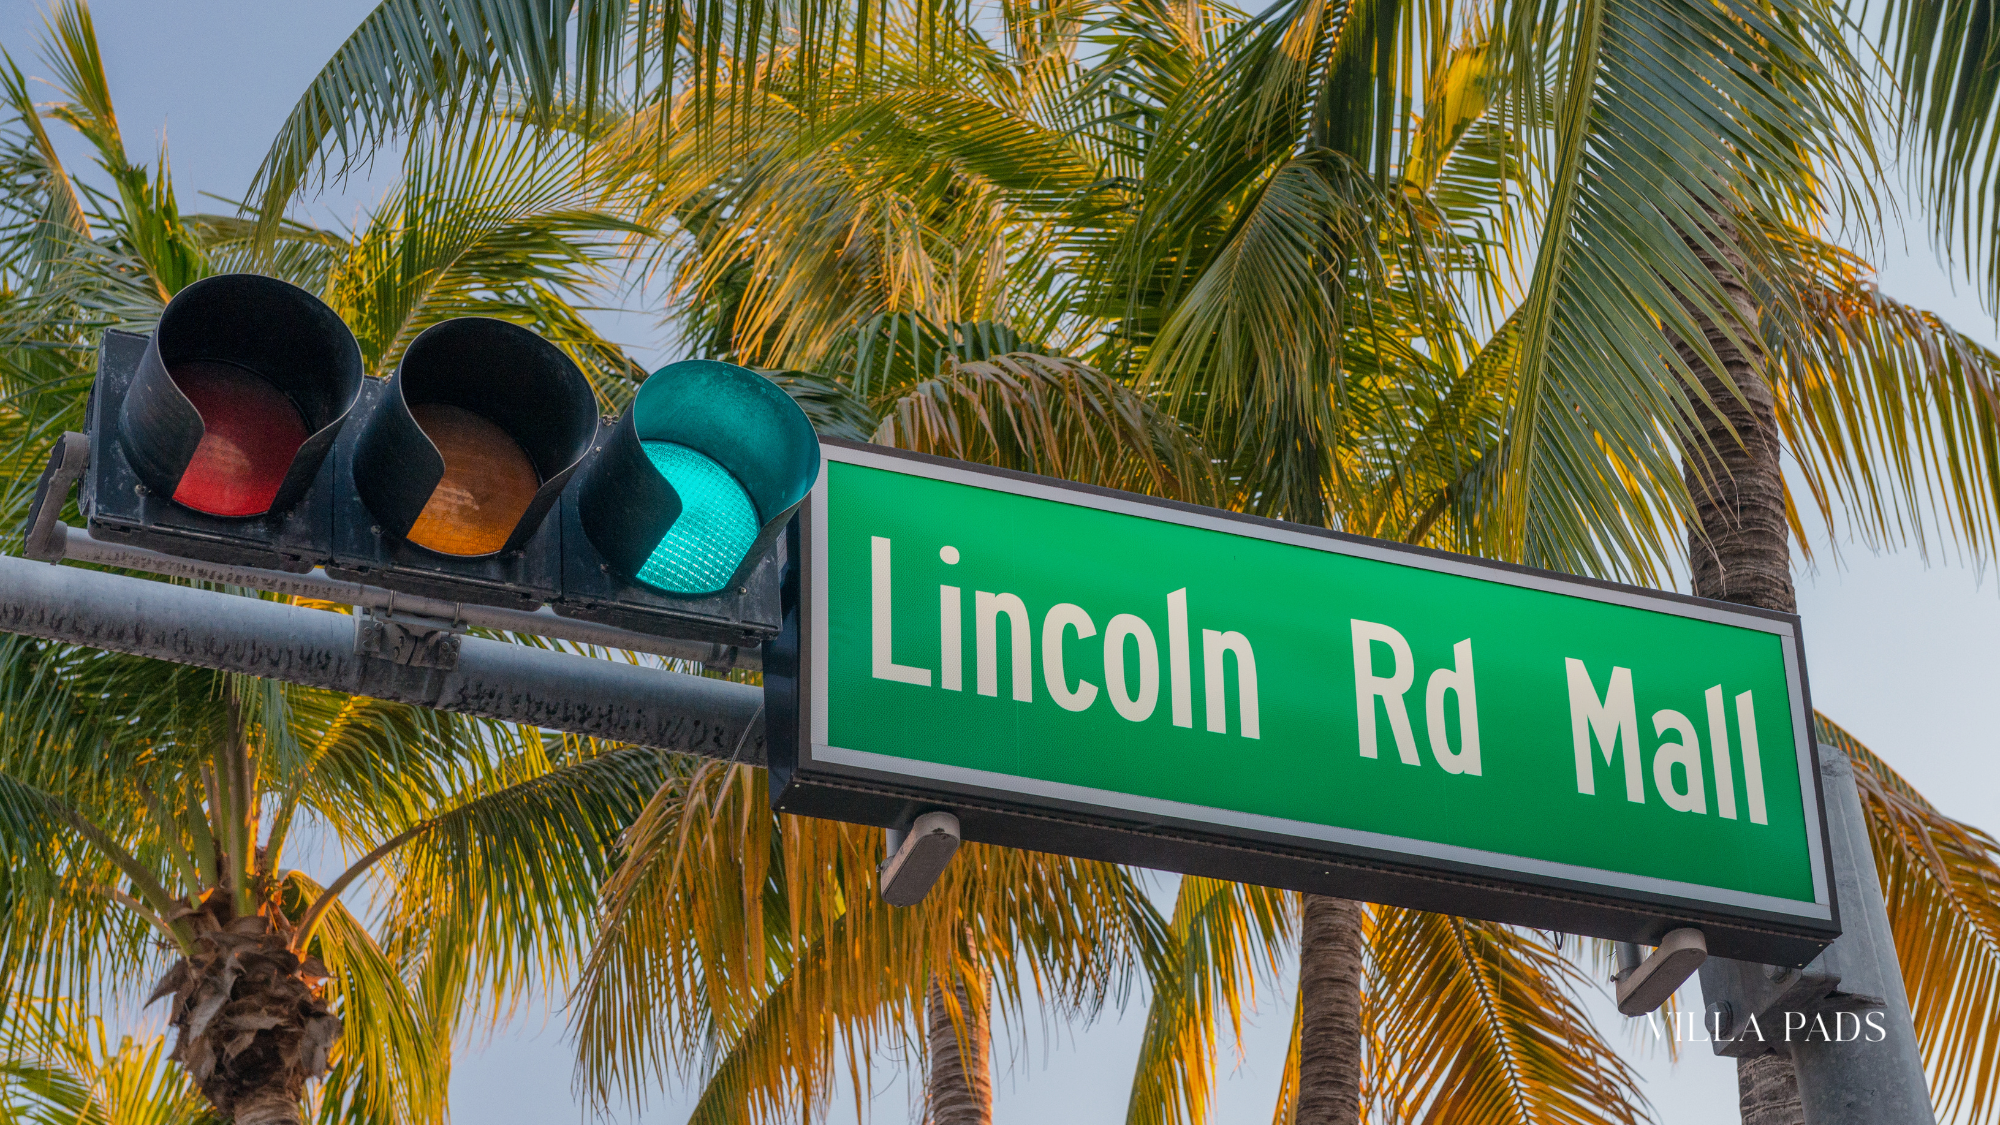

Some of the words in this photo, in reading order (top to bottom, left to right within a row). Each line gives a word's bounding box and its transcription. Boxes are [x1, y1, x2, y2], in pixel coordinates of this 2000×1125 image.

[871, 536, 1259, 740] Lincoln
[1351, 619, 1482, 777] Rd
[1565, 657, 1768, 826] Mall
